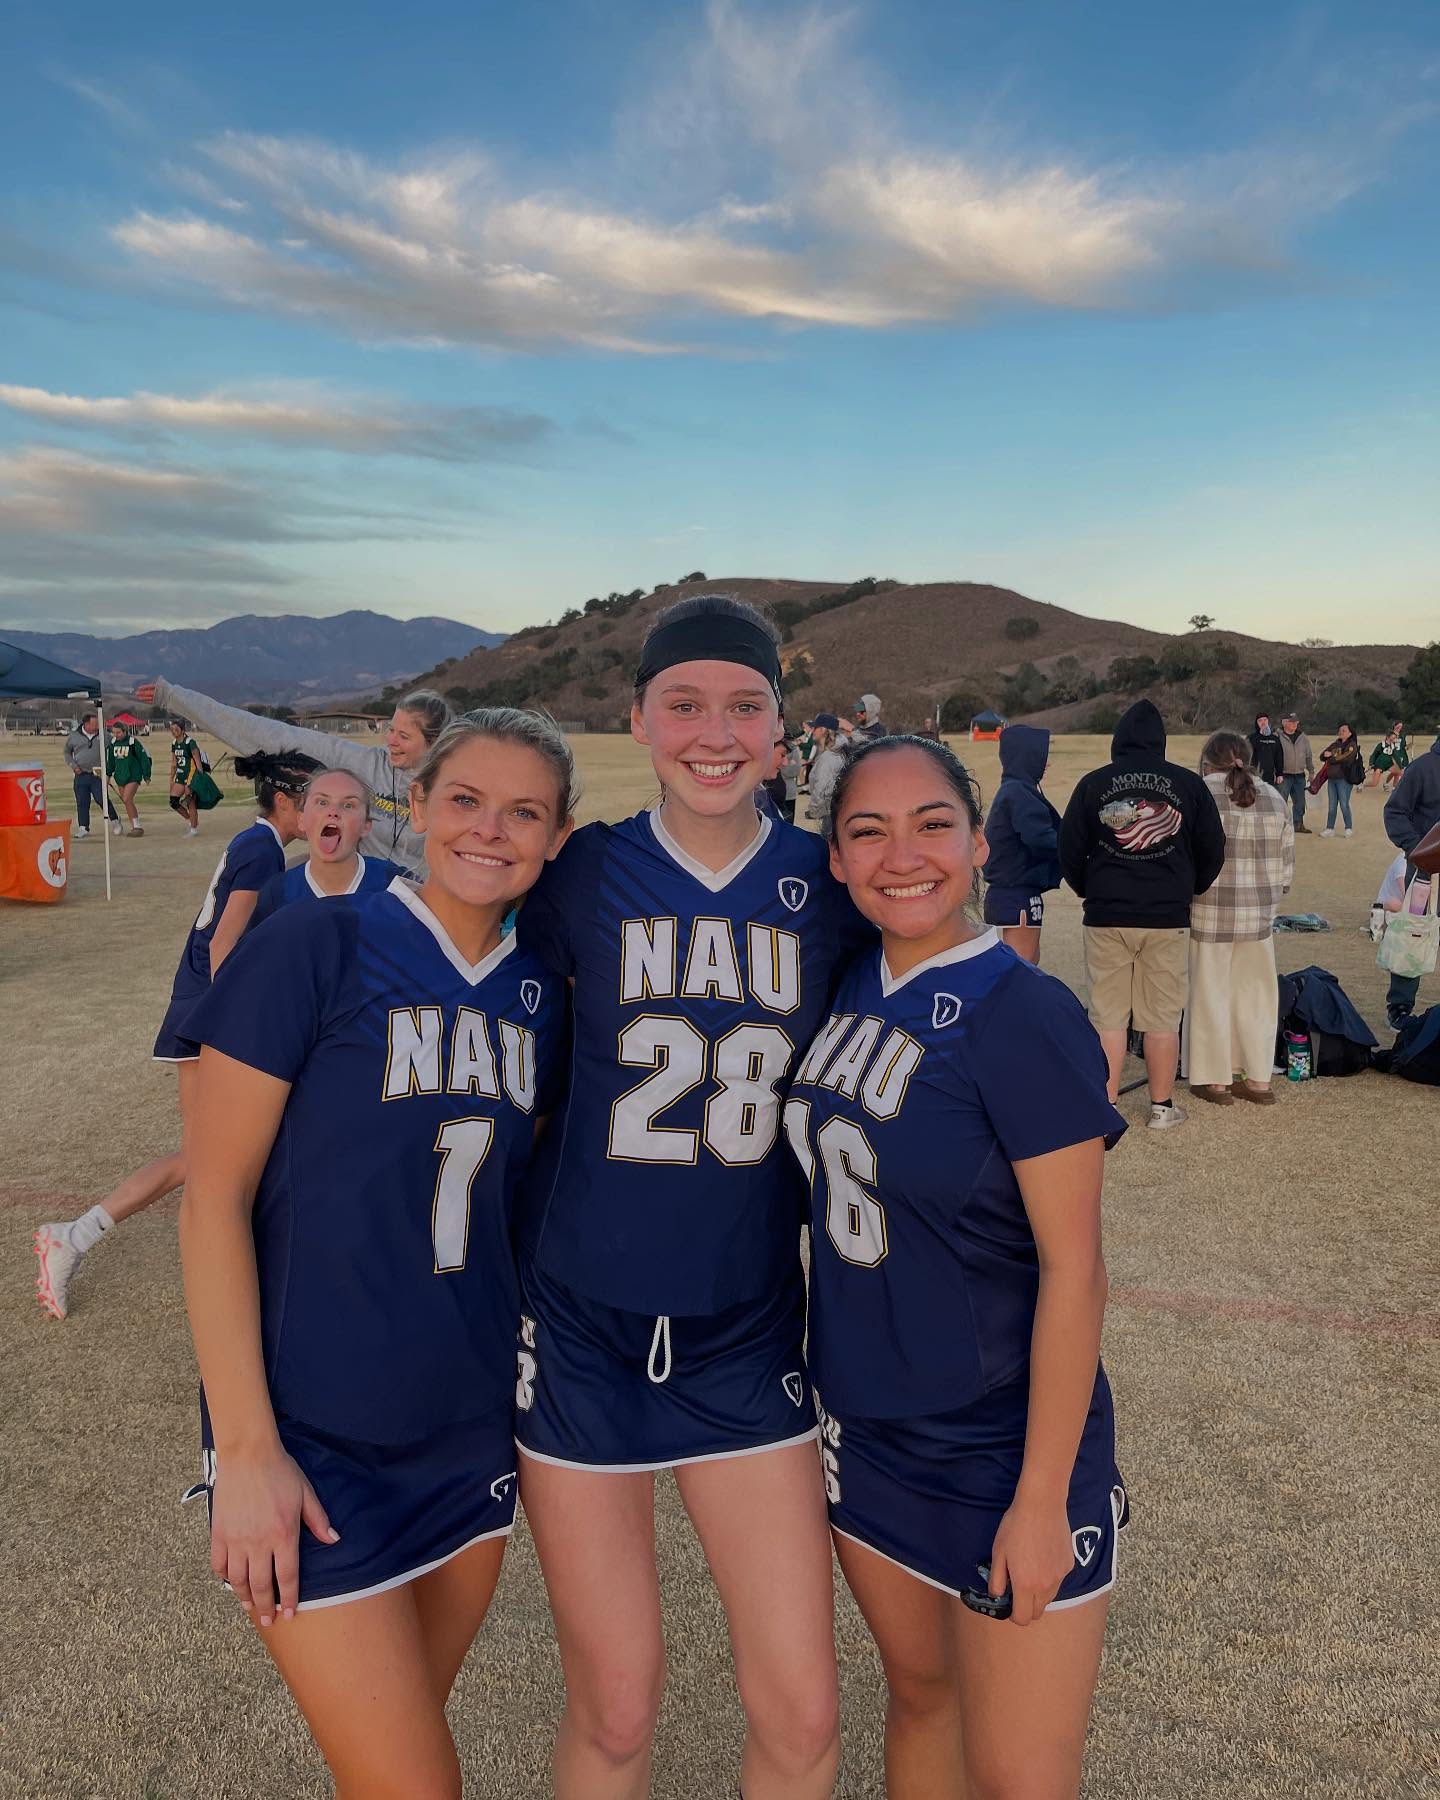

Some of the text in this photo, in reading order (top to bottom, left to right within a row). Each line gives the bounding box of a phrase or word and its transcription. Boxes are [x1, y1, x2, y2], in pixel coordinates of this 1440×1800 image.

[1111, 772, 1172, 789] MONTY'S
[37, 836, 67, 888] G
[1030, 905, 1042, 920] 30
[620, 916, 800, 1016] NAU
[382, 1005, 536, 1115] NAU
[606, 1013, 796, 1166] 28
[791, 1013, 926, 1121] NAU
[431, 1116, 495, 1274] 1
[783, 1098, 889, 1268] 16
